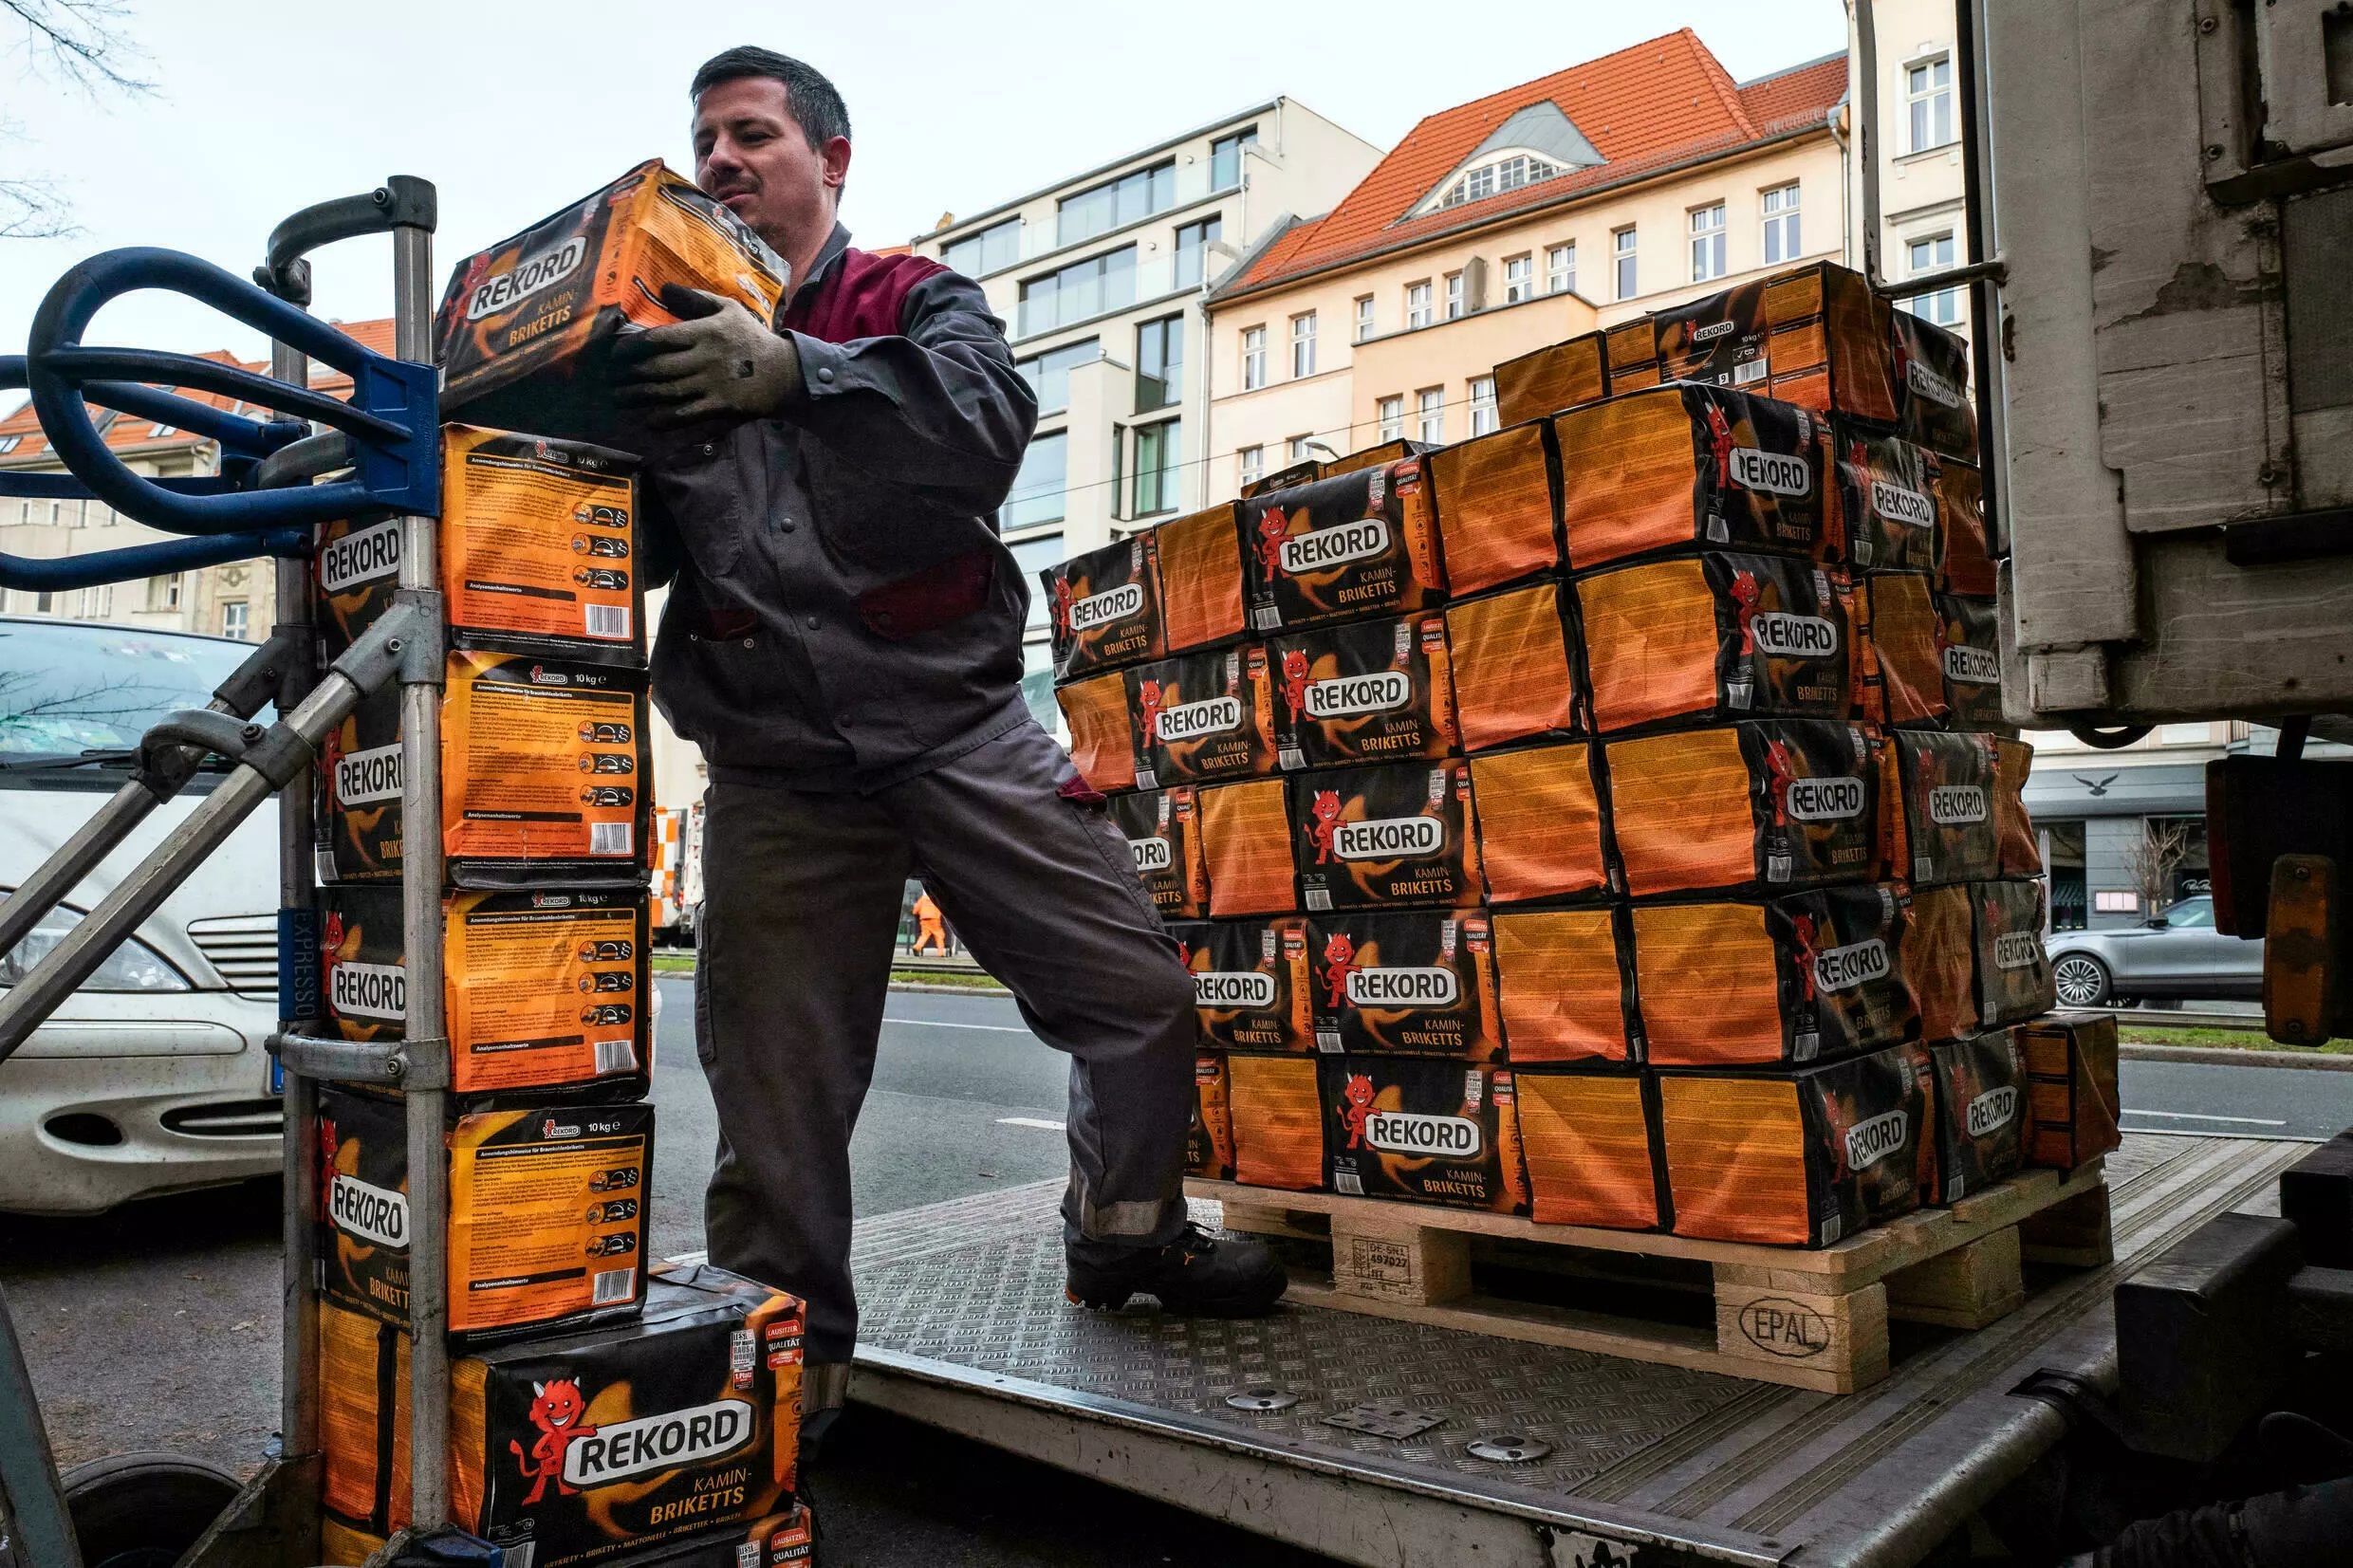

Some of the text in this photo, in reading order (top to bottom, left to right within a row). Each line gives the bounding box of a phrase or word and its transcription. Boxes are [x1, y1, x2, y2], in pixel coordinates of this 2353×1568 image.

[473, 240, 578, 314] REKORD
[509, 304, 572, 347] BRIKETTS
[1695, 323, 1732, 340] REKORD
[585, 455, 598, 468] kg
[1738, 454, 1804, 489] REKORD
[1875, 486, 1930, 523] REKORD
[327, 527, 399, 584] REKORD
[1287, 526, 1380, 567] REKORD
[1360, 566, 1397, 583] KAMIN-
[1338, 580, 1397, 603] BRIKETTS
[1074, 588, 1138, 627] REKORD
[1120, 623, 1149, 639] KAMIN-
[1757, 618, 1832, 650] REKORD
[1103, 635, 1147, 656] BRIKETTS
[1950, 650, 1997, 678] REKORD
[540, 674, 565, 683] REKORD
[575, 673, 584, 683] 10
[585, 674, 597, 686] kg
[1311, 678, 1401, 711] REKORD
[1796, 685, 1838, 702] BRIKETTS
[1161, 702, 1235, 736] REKORD
[1384, 719, 1422, 734] KAMIN-
[1217, 740, 1251, 754] KAMIN-
[1361, 732, 1421, 752] BRIKETTS
[1200, 752, 1249, 770] BRIKETTS
[1793, 784, 1860, 814] REKORD
[1933, 791, 1983, 818] REKORD
[1340, 822, 1434, 854] REKORD
[1133, 842, 1166, 866] ORD
[1831, 847, 1867, 865] BRIKETTS
[1415, 866, 1451, 879] KAMIN-
[1390, 879, 1454, 896] BRIKETTS
[586, 895, 599, 905] kg
[1997, 935, 2035, 963] REKORD
[293, 911, 316, 1018] EXPRESSO
[1818, 945, 1884, 987] REKORD
[336, 969, 405, 1011] REKORD
[1195, 977, 1267, 1001] REKORD
[1353, 973, 1449, 999] REKORD
[1233, 1029, 1282, 1043] BRIKETTS
[1252, 1019, 1280, 1030] KAMIN-
[1424, 1019, 1464, 1031] KAMIN-
[1401, 1031, 1463, 1046] BRIKETTS
[1971, 1091, 2012, 1132] REKORD
[552, 1127, 578, 1135] REKORD
[587, 1122, 598, 1132] 10
[599, 1121, 611, 1133] kg
[1373, 1117, 1472, 1150] REKORD
[1851, 1116, 1902, 1165] REKORD
[1446, 1169, 1487, 1183] KAMIN-
[1423, 1179, 1486, 1198] BRIKETTS
[334, 1181, 403, 1240] REKORD
[1371, 1254, 1408, 1268] 497027
[385, 1266, 410, 1287] KAMI
[369, 1276, 410, 1310] BRIKETT
[768, 1325, 799, 1337] LAUSITZER
[1754, 1309, 1824, 1350] EPAL
[768, 1337, 801, 1353] QUALITÄT
[578, 1408, 739, 1478] REKORD
[694, 1467, 752, 1492] KAMIN-
[650, 1485, 745, 1525] BRIKETTS
[773, 1545, 809, 1563] QUALITÄT
